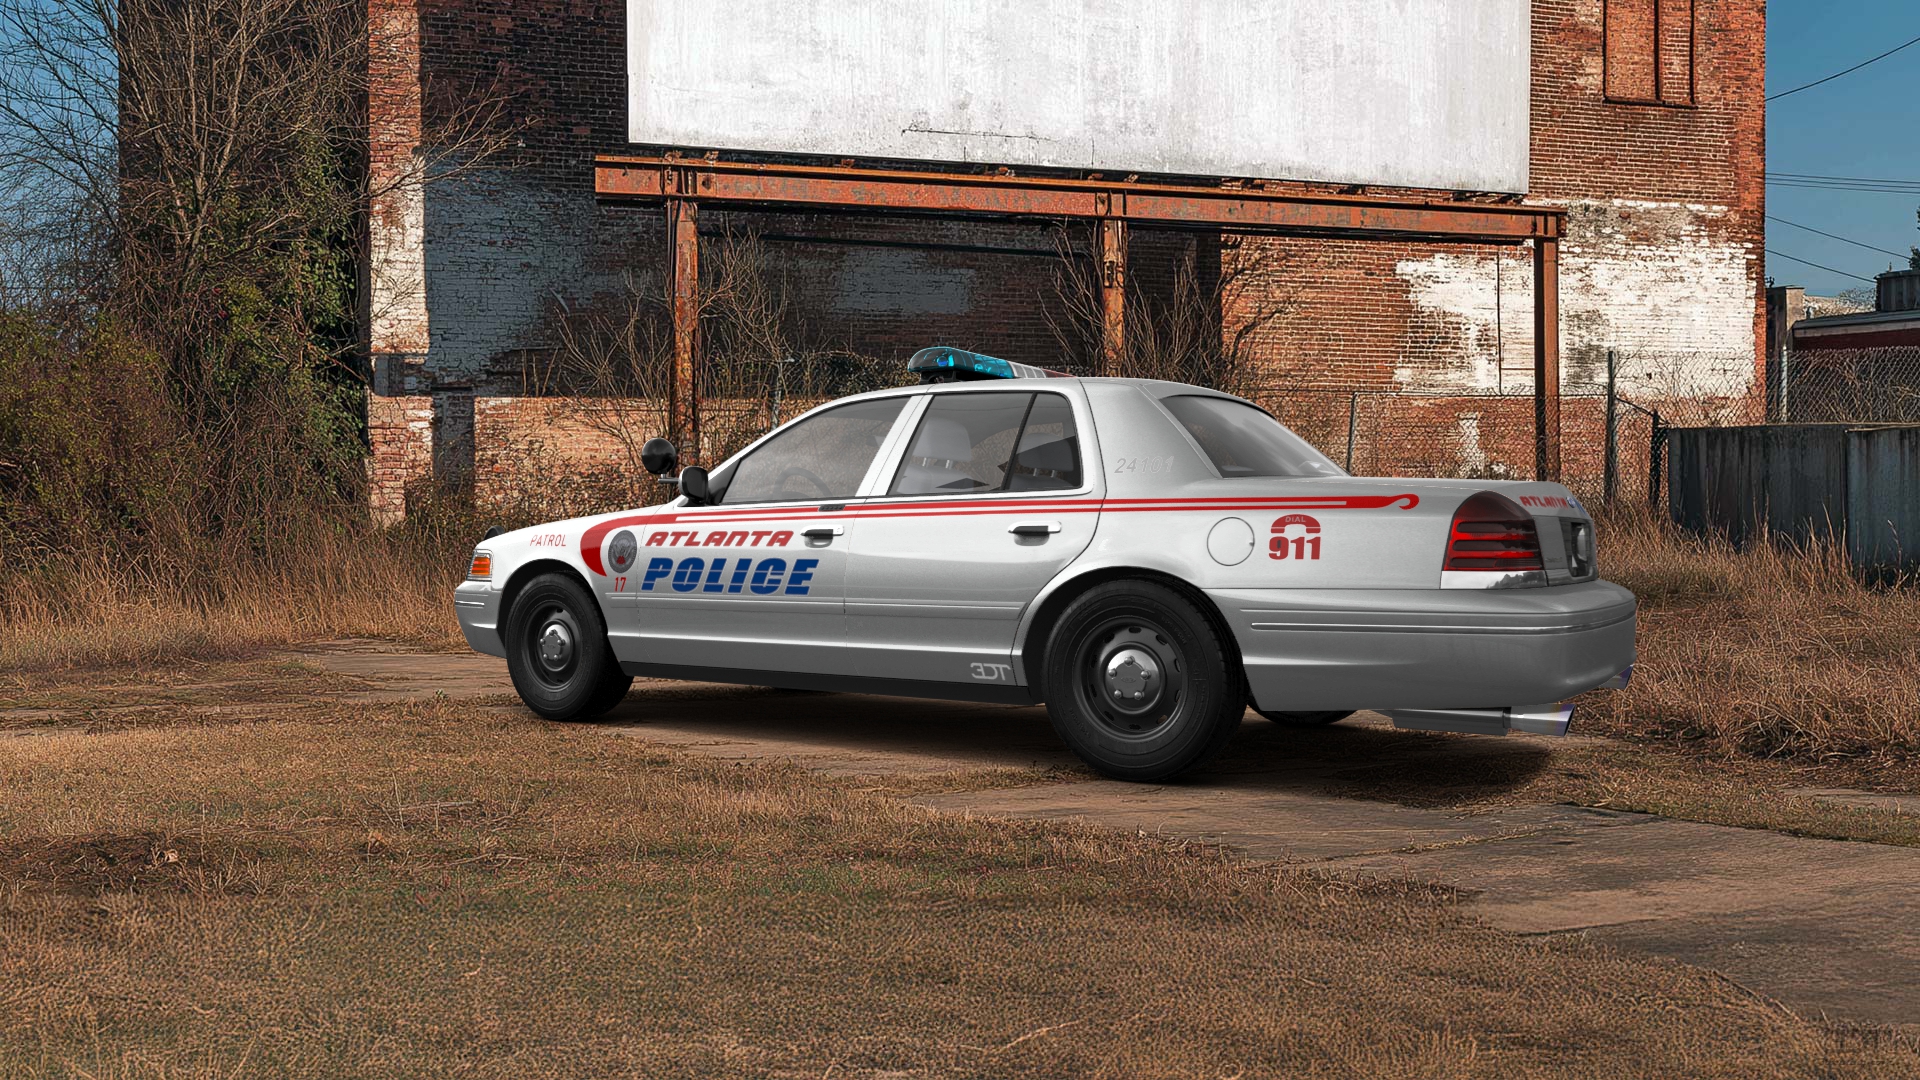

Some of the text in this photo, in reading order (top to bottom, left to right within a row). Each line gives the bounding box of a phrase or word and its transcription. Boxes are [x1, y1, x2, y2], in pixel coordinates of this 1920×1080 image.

[1114, 456, 1175, 474] 24101
[529, 534, 567, 547] PATROL
[645, 530, 794, 547] ATLANTA
[1268, 536, 1321, 560] 911
[614, 576, 627, 592] 17
[641, 557, 819, 596] POLICE
